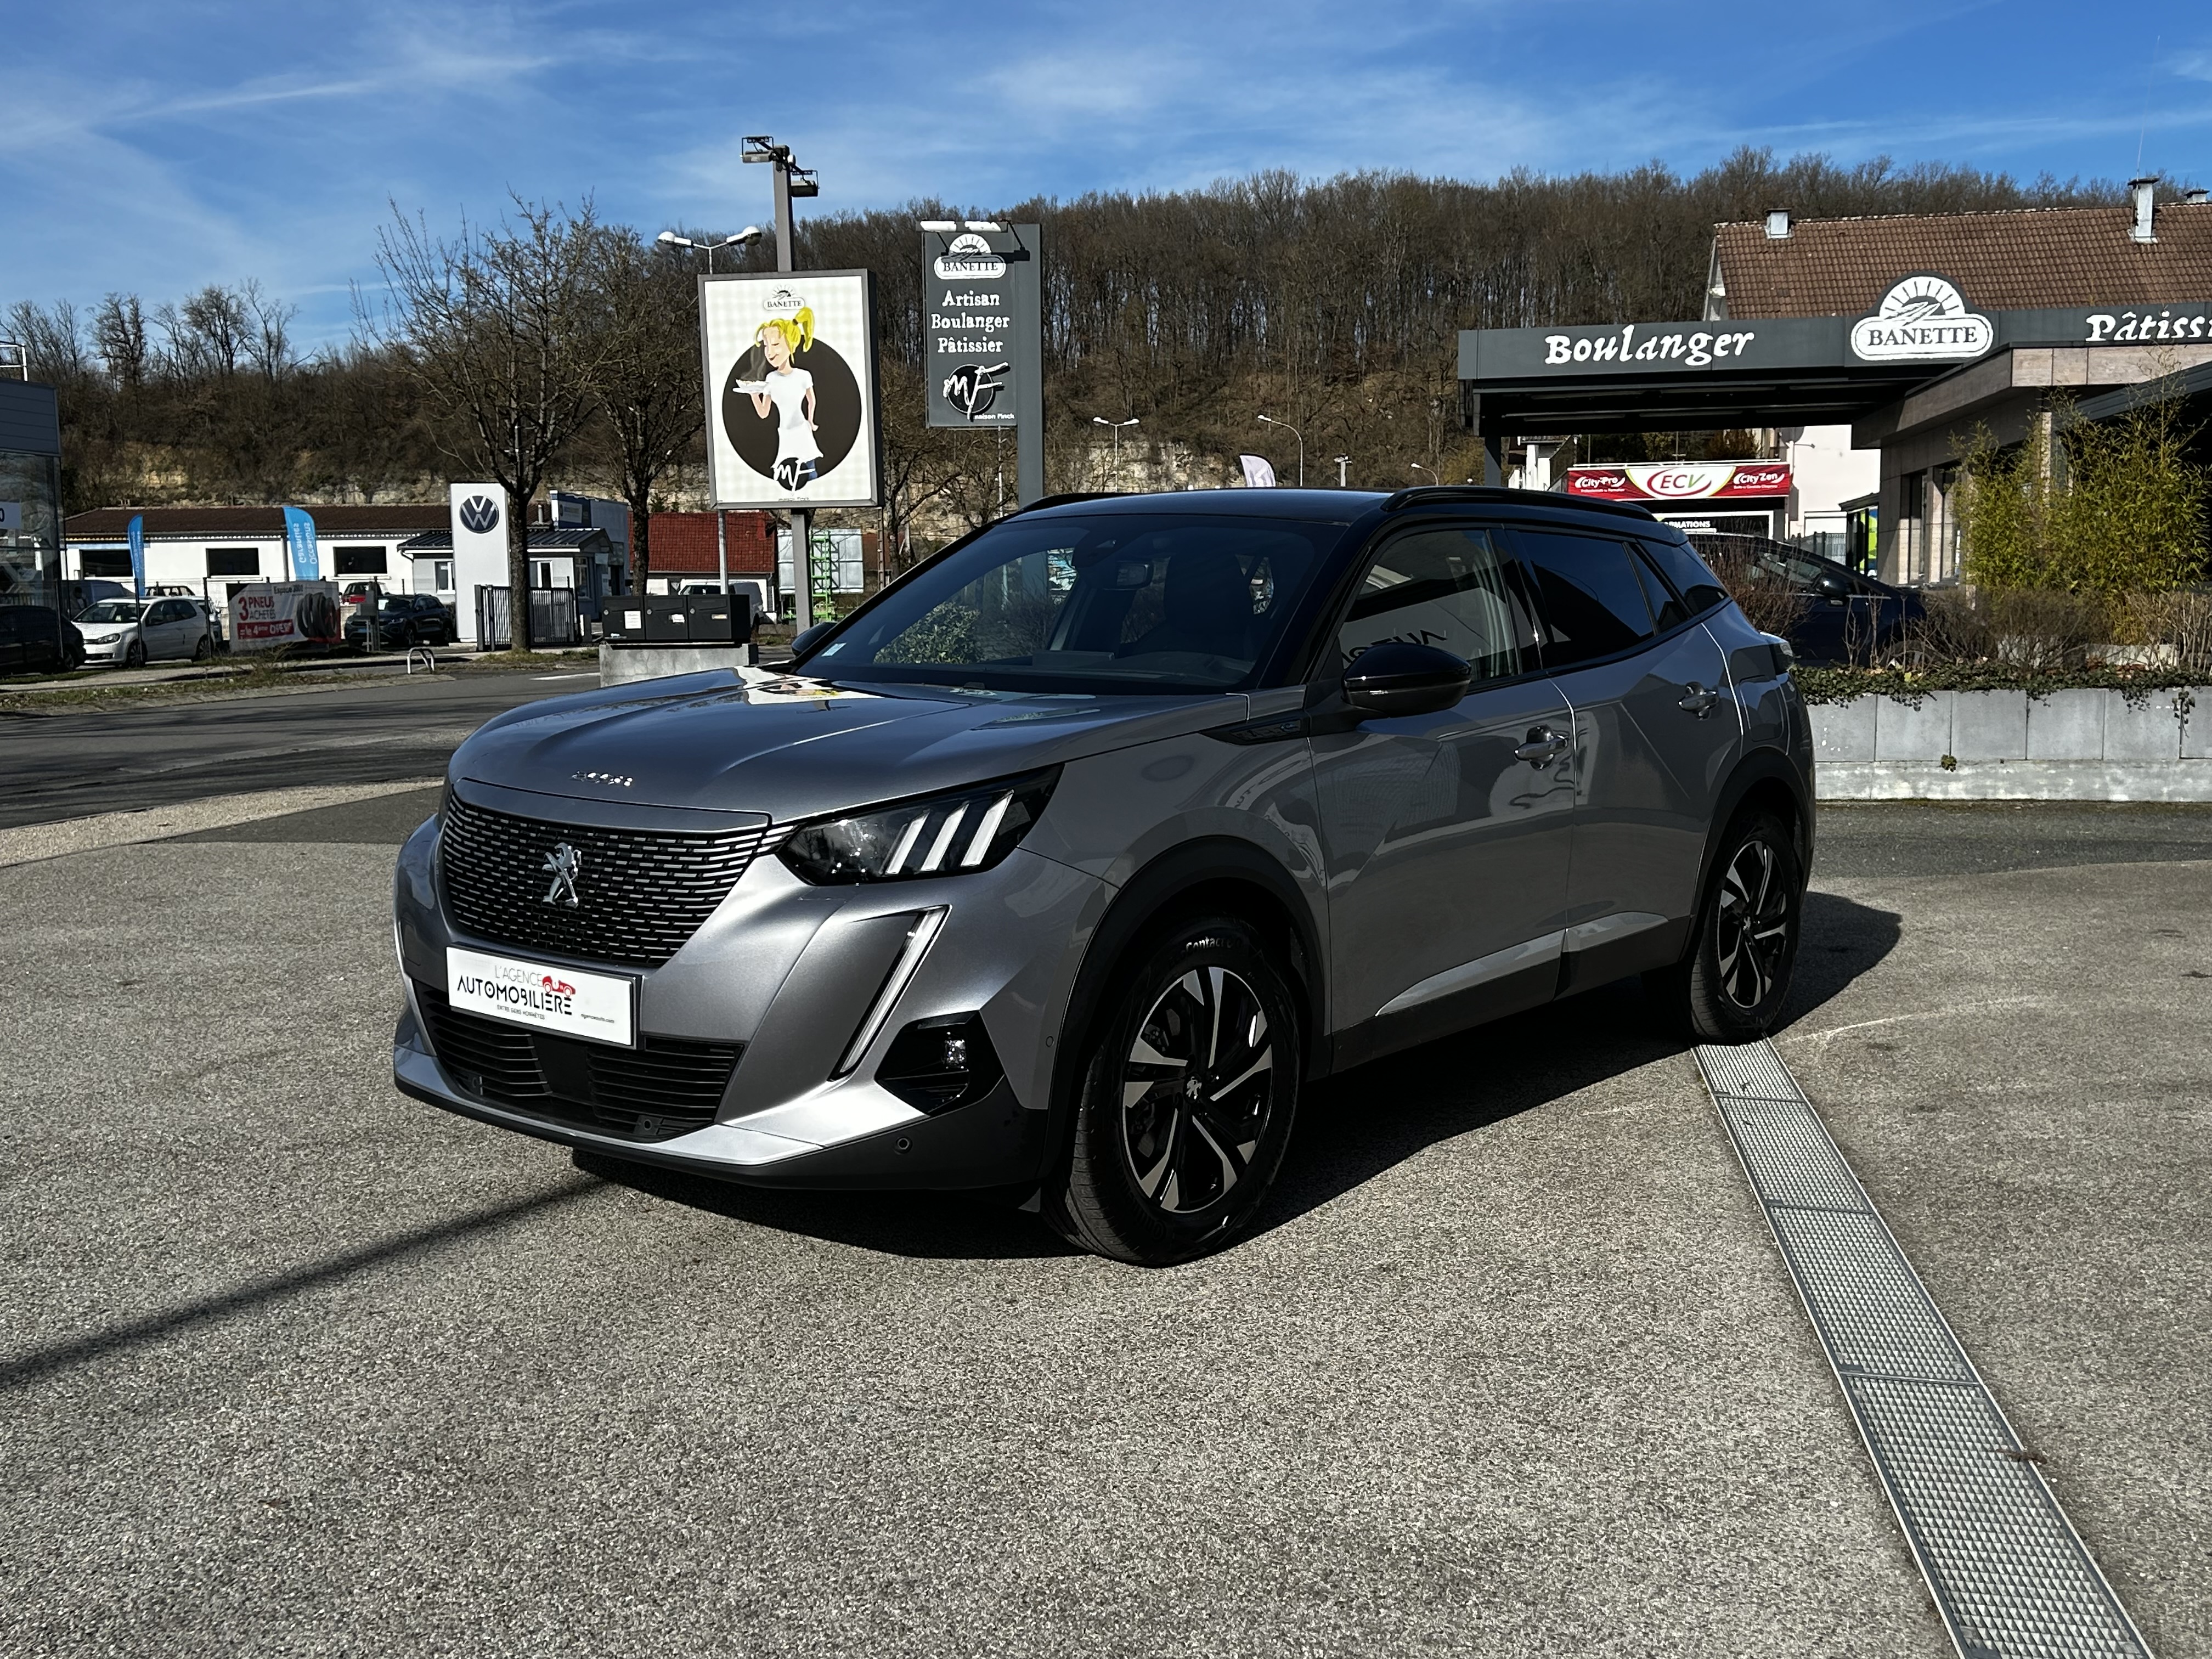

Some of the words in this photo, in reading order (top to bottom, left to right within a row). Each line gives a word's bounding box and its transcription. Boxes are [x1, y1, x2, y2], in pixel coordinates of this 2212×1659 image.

[943, 261, 998, 273] BANETTE
[942, 290, 1000, 307] Artisan
[931, 313, 1010, 332] Boulanger
[937, 336, 1003, 353] Pâtissier
[1544, 324, 1755, 366] Boulanger
[1867, 326, 1978, 346] BANETTE
[1660, 473, 1705, 489] ECV
[238, 596, 249, 621] 3
[249, 596, 274, 608] PNEUS
[494, 964, 543, 988] L'AGENCE
